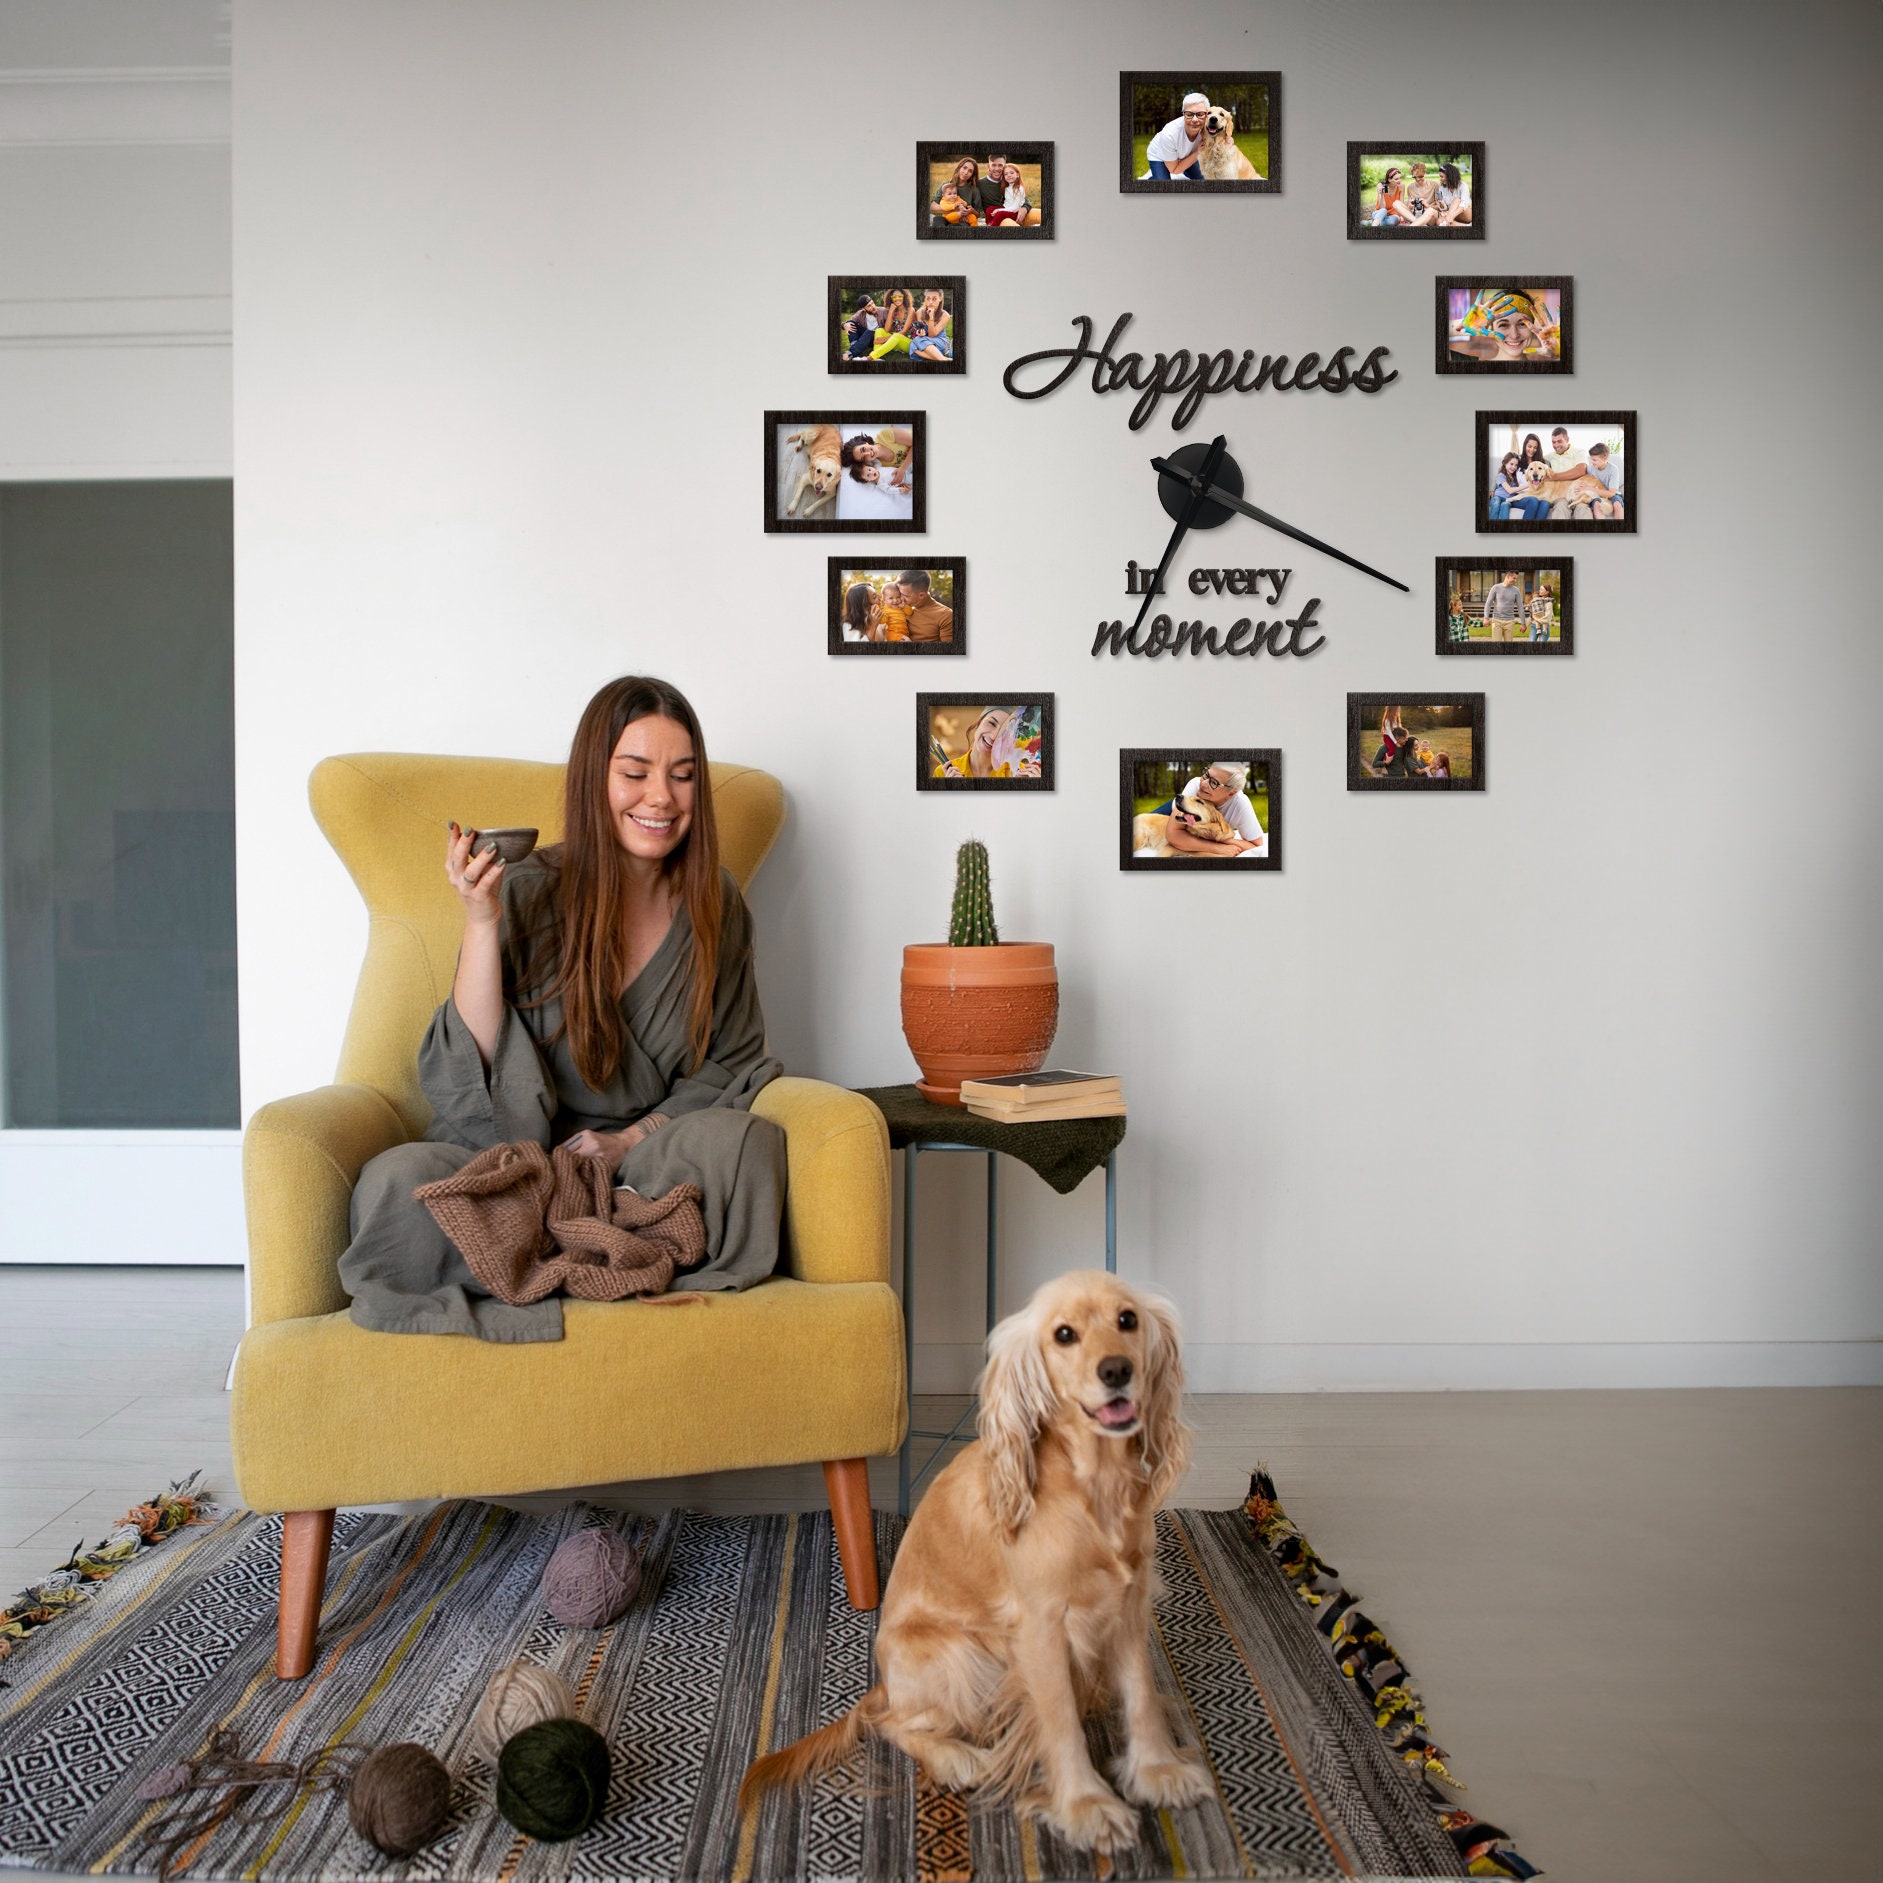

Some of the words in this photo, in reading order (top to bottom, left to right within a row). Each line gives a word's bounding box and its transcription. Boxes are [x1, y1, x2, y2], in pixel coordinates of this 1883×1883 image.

[1003, 312, 1398, 431] Happiness
[1125, 560, 1166, 595] in
[1188, 567, 1293, 605] every
[1091, 598, 1326, 657] moment
